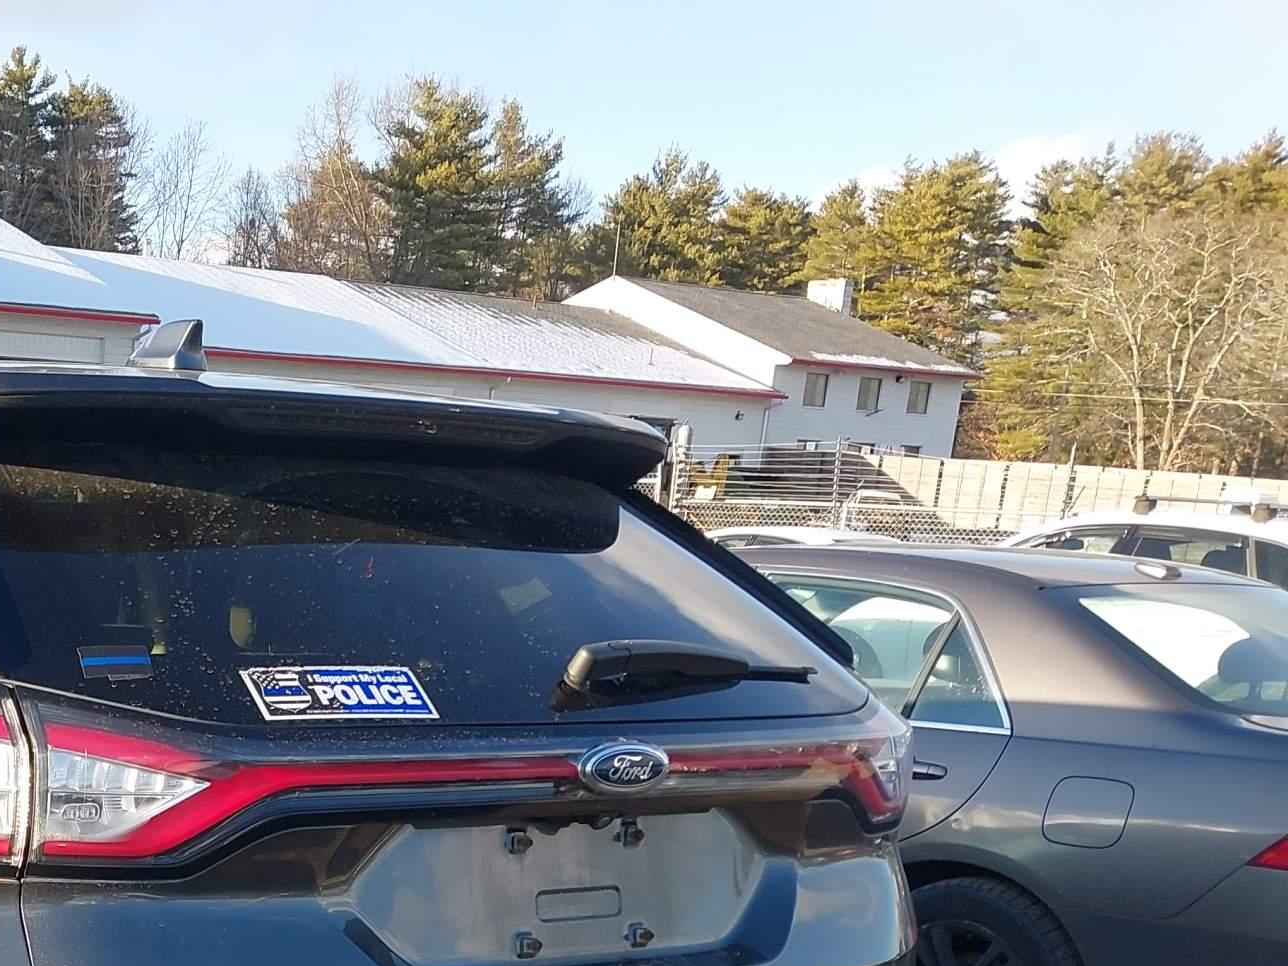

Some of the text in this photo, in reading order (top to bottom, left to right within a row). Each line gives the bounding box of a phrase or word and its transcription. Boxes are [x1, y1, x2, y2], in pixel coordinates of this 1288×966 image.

[313, 674, 359, 684] Support
[359, 674, 376, 684] My
[376, 674, 408, 683] Local
[308, 684, 422, 706] POLICE
[609, 755, 653, 781] Ford
